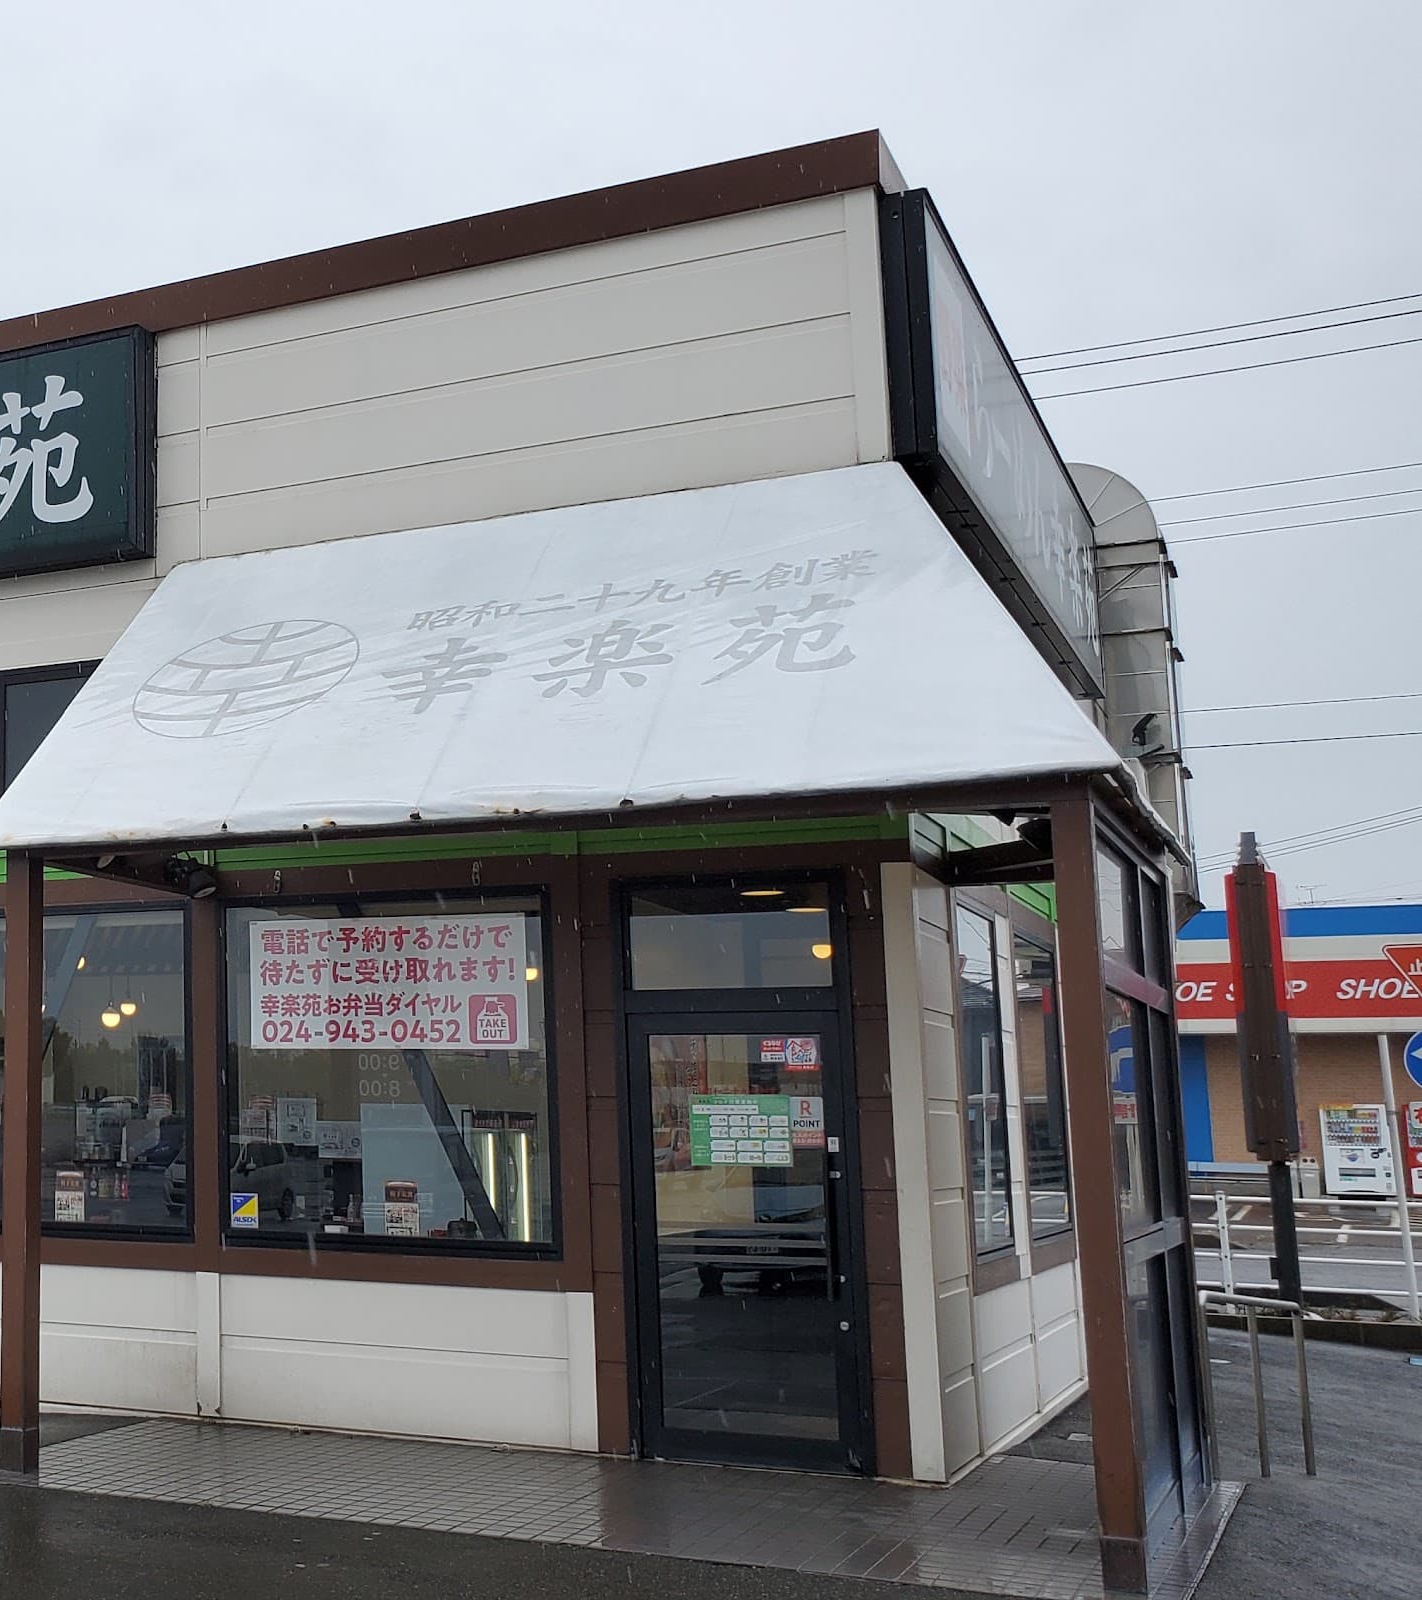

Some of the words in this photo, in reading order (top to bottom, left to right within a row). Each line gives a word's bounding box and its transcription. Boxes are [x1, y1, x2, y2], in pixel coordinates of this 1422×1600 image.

[406, 549, 878, 632] 昭和二十九年創業
[380, 593, 858, 715] 幸楽苑
[260, 924, 513, 955] 電話で予約するだけで
[259, 955, 516, 986] 待たずに受け取れます!
[1174, 981, 1218, 1001] OE
[260, 991, 462, 1018] 幸楽苑お弁当ダイヤル
[262, 1019, 461, 1043] 024-943-0452
[479, 1018, 507, 1029] TAKE
[482, 1029, 505, 1039] OUT
[800, 1100, 812, 1115] R
[793, 1120, 820, 1128] POINT
